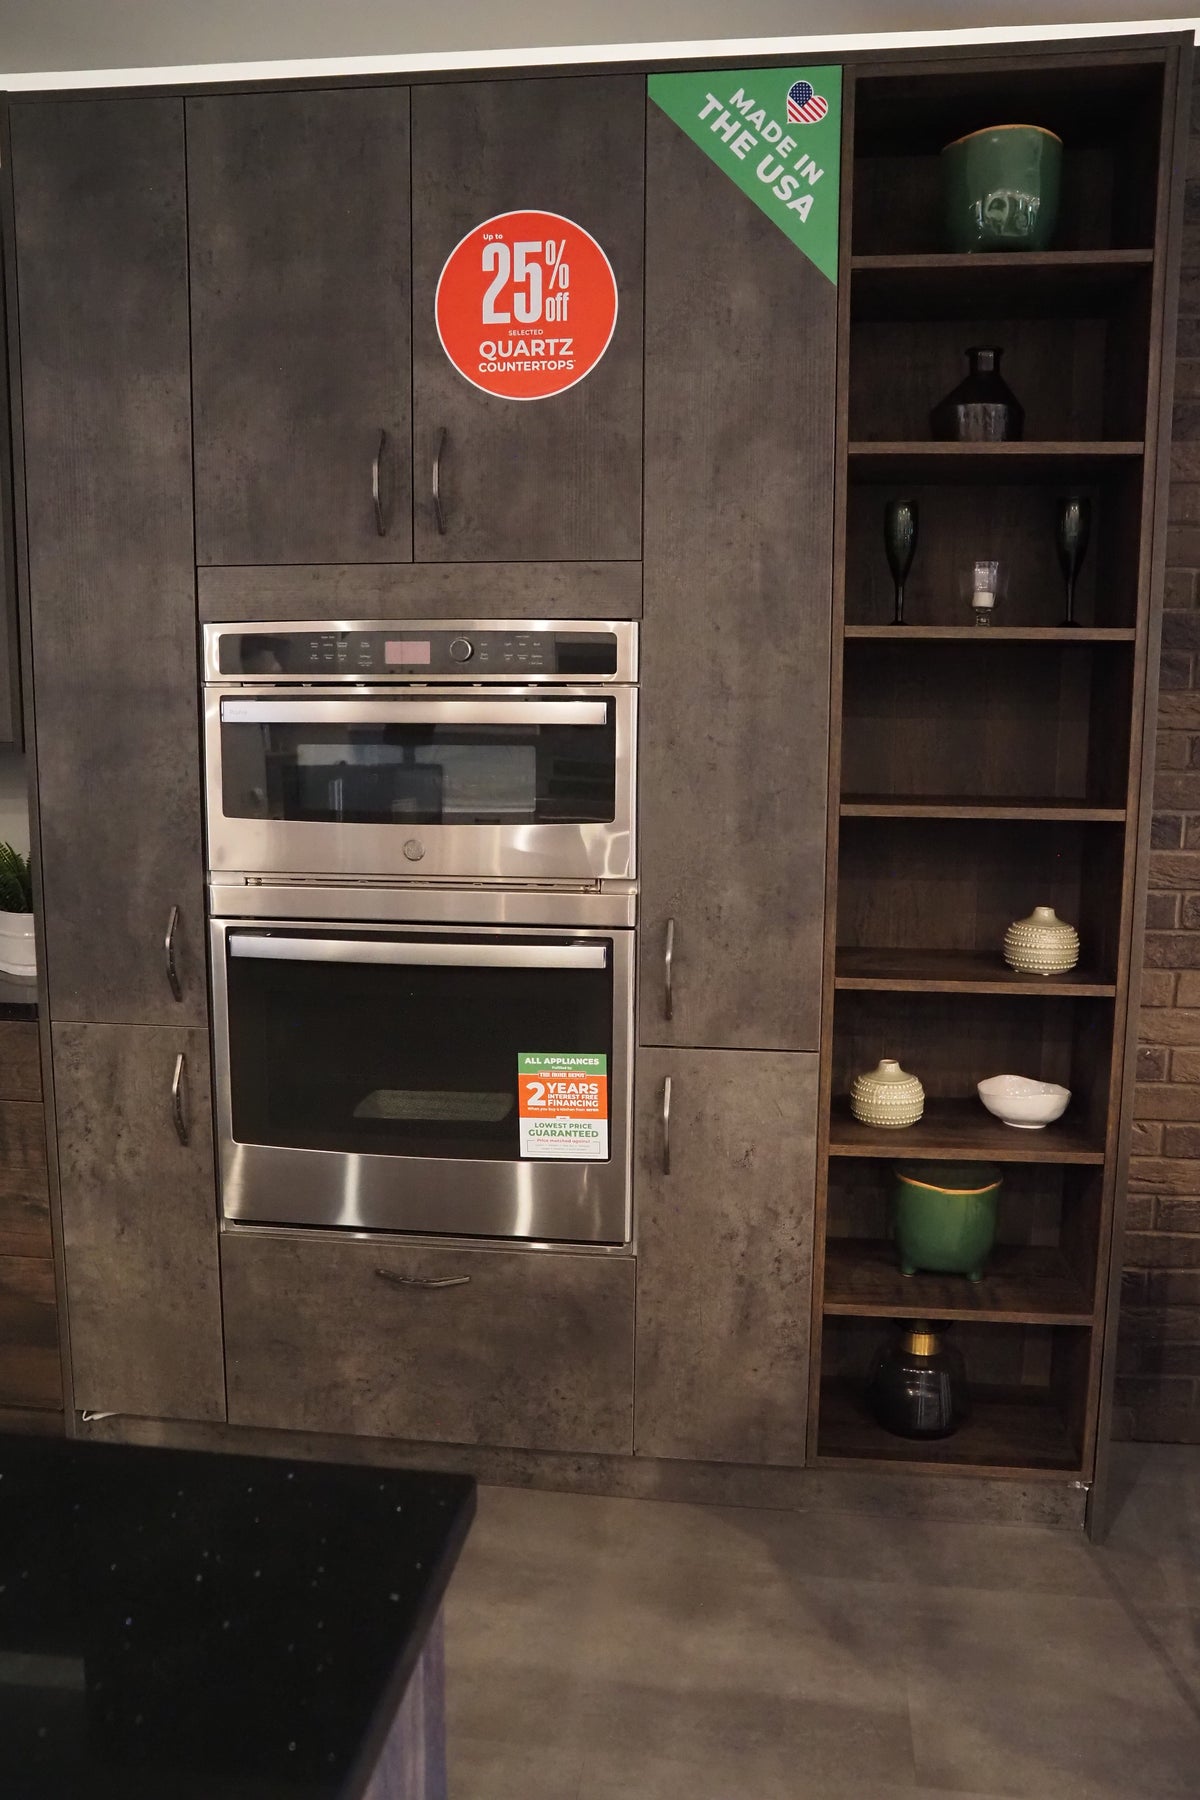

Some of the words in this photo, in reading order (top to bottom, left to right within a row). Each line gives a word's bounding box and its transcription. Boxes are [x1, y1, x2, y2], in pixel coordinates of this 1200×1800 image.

[729, 87, 798, 158] MADE
[793, 153, 824, 186] IN
[697, 92, 758, 160] THE
[756, 153, 814, 223] USA
[481, 239, 569, 324] 25%
[545, 292, 569, 322] off
[508, 329, 544, 337] SELECTED
[479, 338, 574, 361] QUARTZ
[525, 1057, 542, 1065] ALL
[544, 1058, 599, 1066] APPLIANCES
[526, 1081, 546, 1106] 2
[546, 1082, 599, 1094] YEARS
[547, 1099, 599, 1107] FINANCING
[528, 1129, 599, 1138] GUARANTEED
